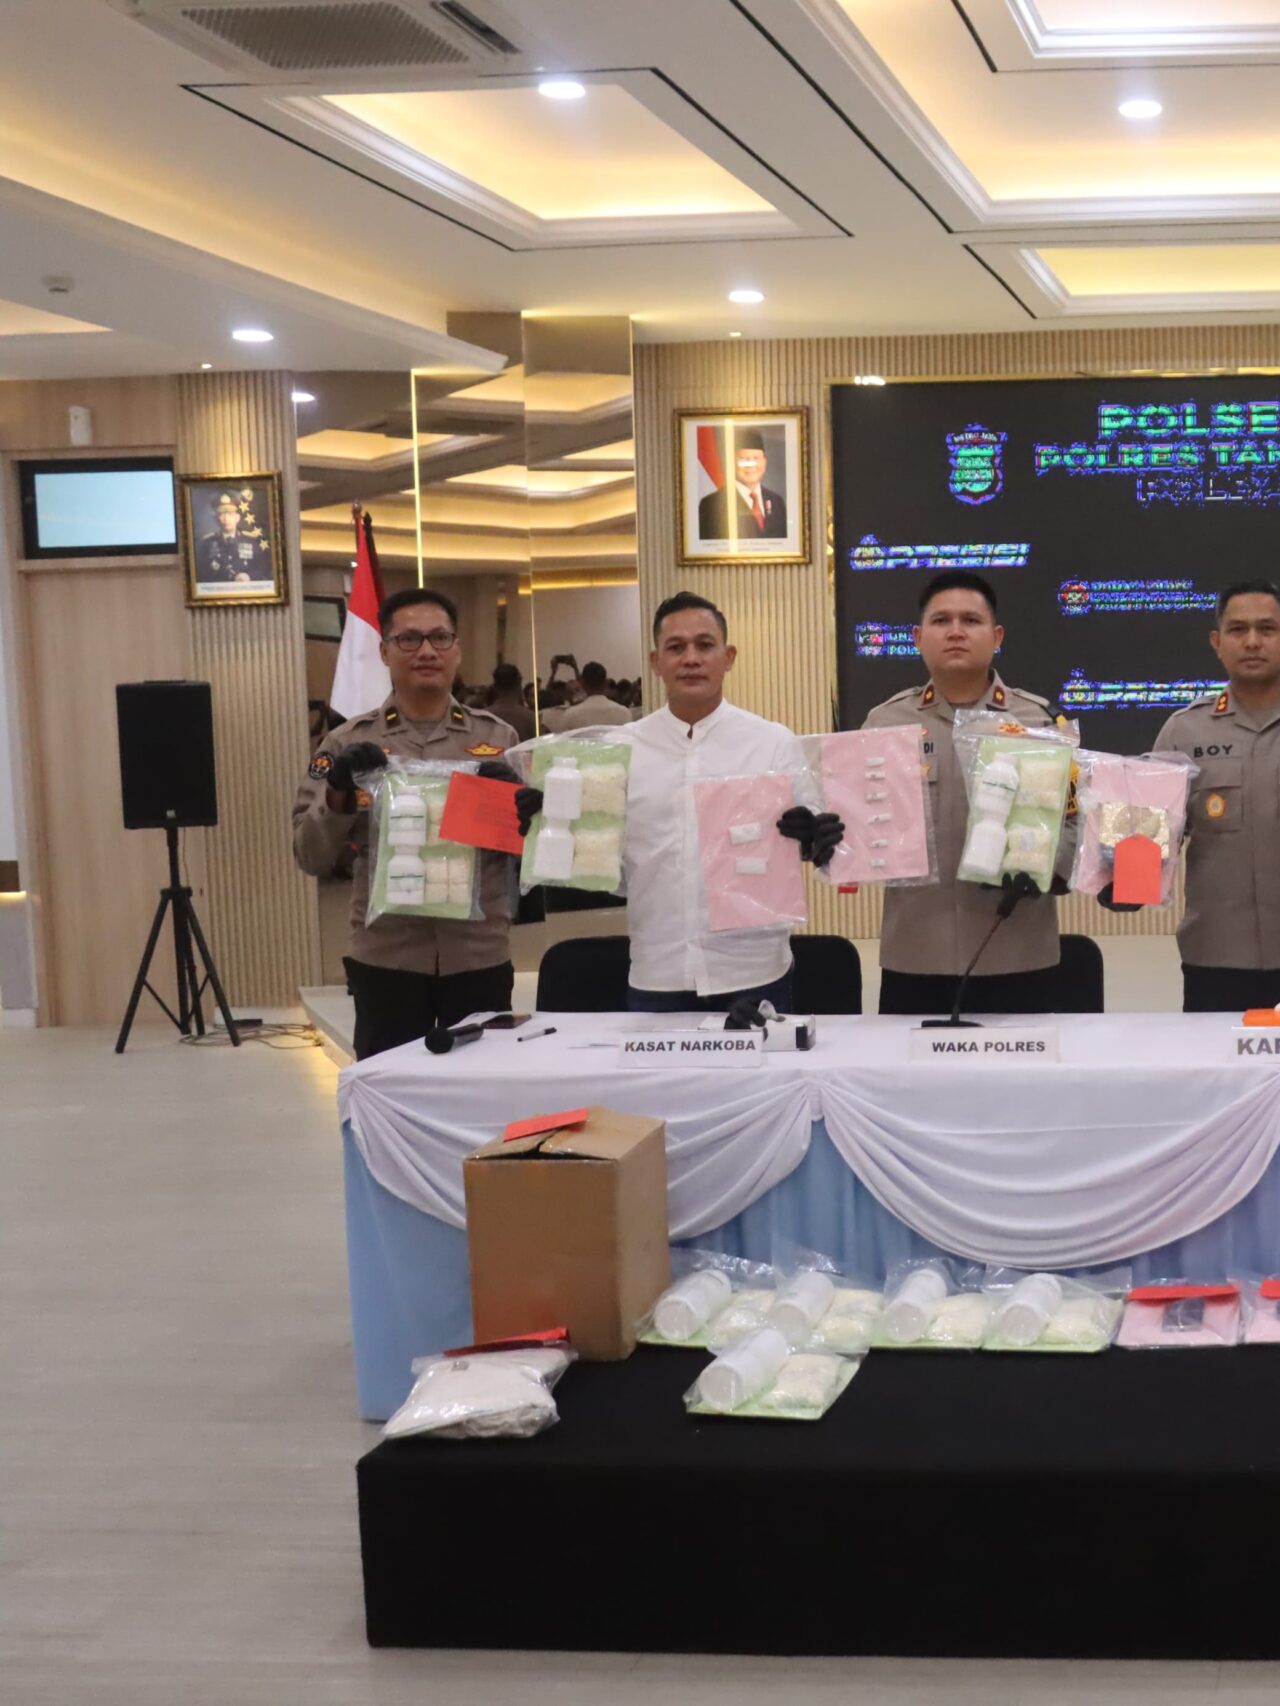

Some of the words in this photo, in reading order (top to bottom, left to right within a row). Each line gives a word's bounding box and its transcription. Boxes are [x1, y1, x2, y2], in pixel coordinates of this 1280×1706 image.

[1036, 443, 1202, 473] POLRES
[1193, 744, 1234, 758] BOY
[624, 1040, 676, 1052] KASAT
[680, 1039, 756, 1052] NARKOBA
[931, 1041, 979, 1053] WAKA
[984, 1040, 1046, 1053] POLRES
